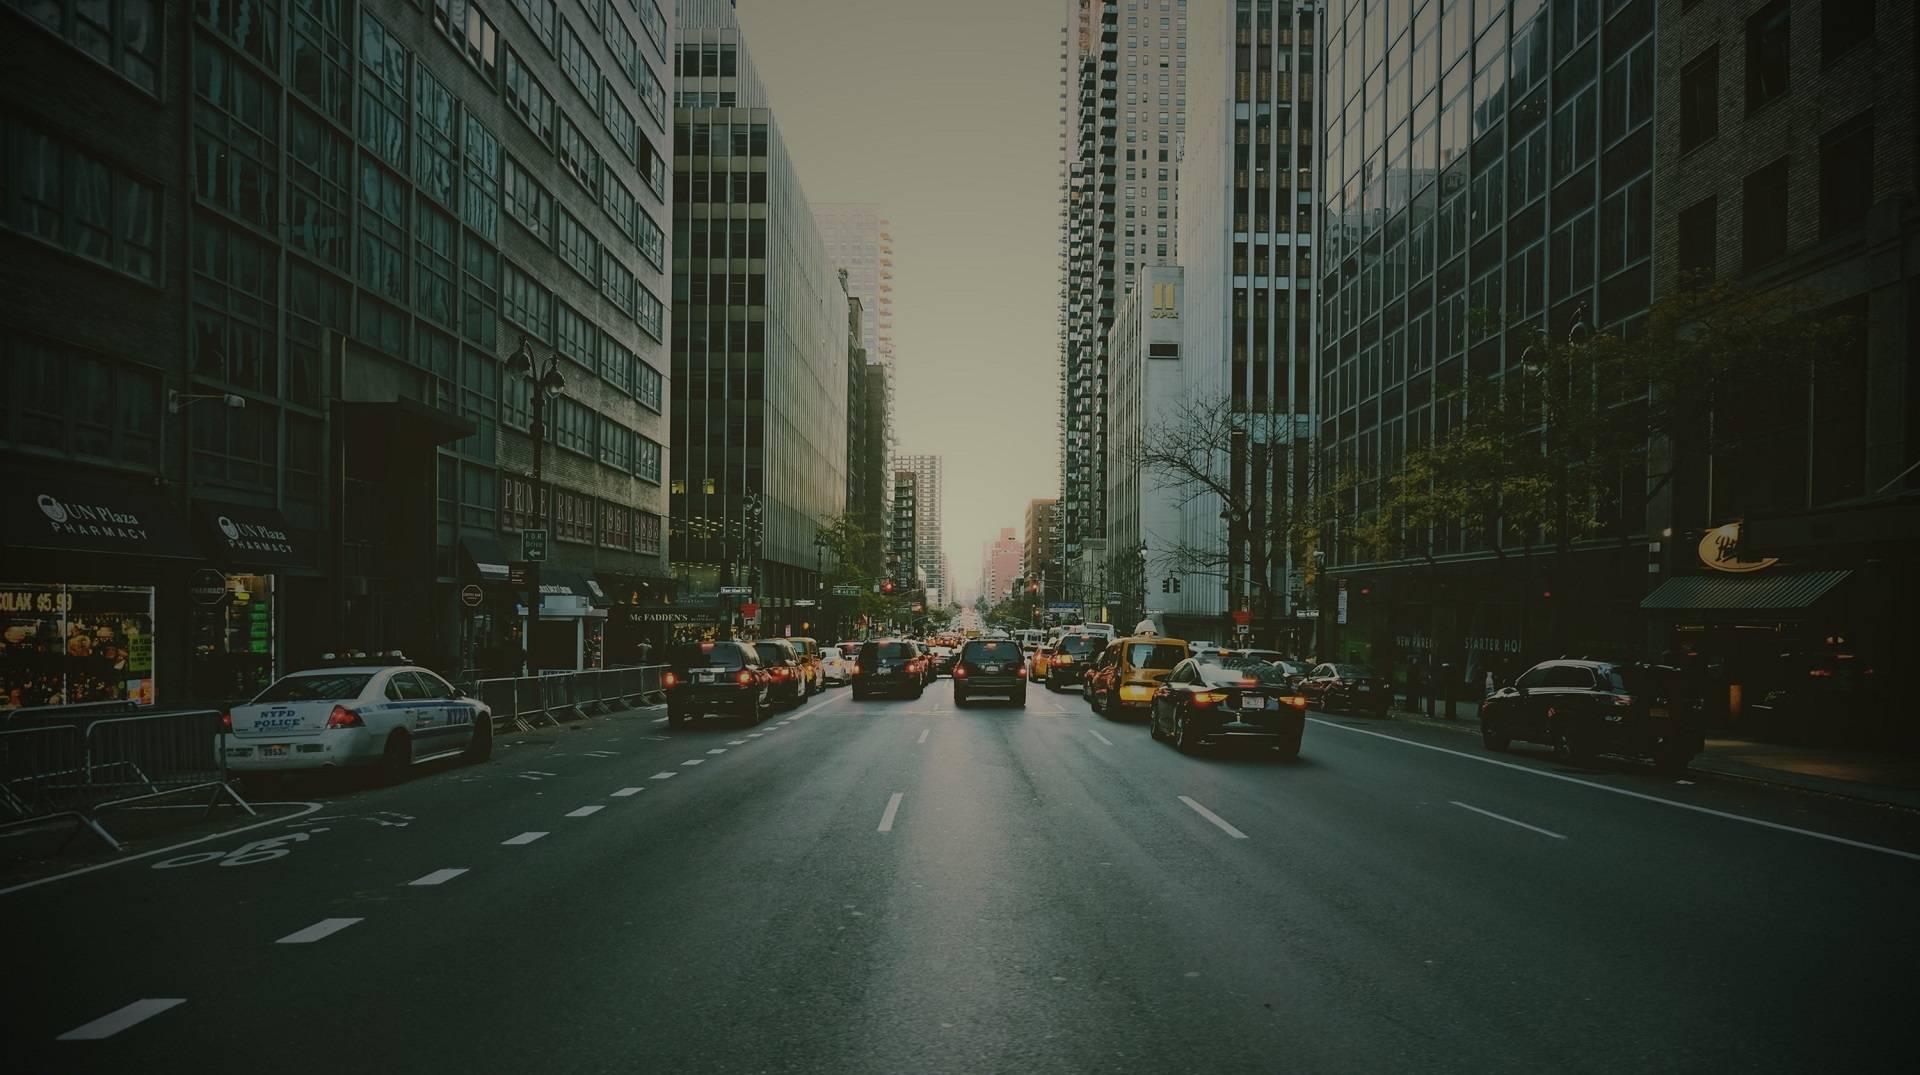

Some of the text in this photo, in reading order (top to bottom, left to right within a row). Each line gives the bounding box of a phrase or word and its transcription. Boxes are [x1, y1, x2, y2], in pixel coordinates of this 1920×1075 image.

[64, 503, 139, 525] UN Plaza
[51, 522, 148, 540] PHARMACY
[235, 523, 287, 541] UN Plaza
[227, 539, 293, 553] PHARMACY
[36, 592, 73, 613] $5.99
[630, 613, 643, 622] Mc
[644, 613, 688, 622] FADDEN'S
[1465, 637, 1500, 651] STARTER
[260, 710, 296, 718] NYPD
[254, 718, 301, 728] POLICE
